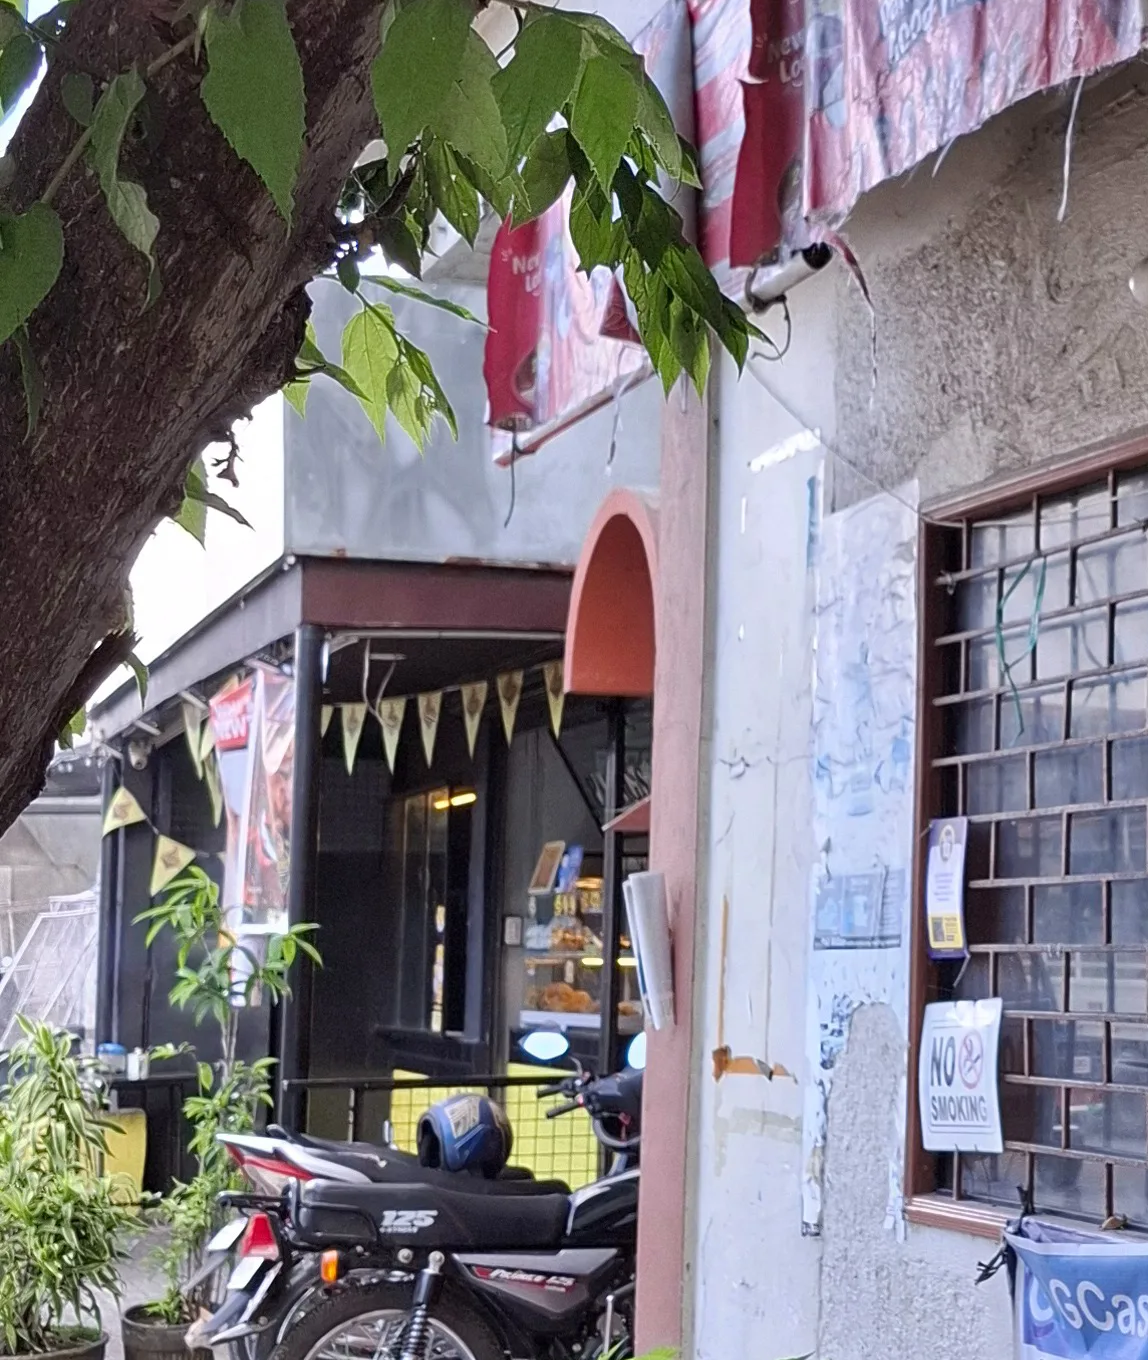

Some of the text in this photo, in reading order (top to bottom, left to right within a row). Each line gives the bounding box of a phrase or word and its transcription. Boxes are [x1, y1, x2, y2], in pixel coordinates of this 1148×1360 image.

[930, 1035, 957, 1088] NO
[930, 1095, 988, 1123] SMOKING
[382, 1209, 439, 1228] 125
